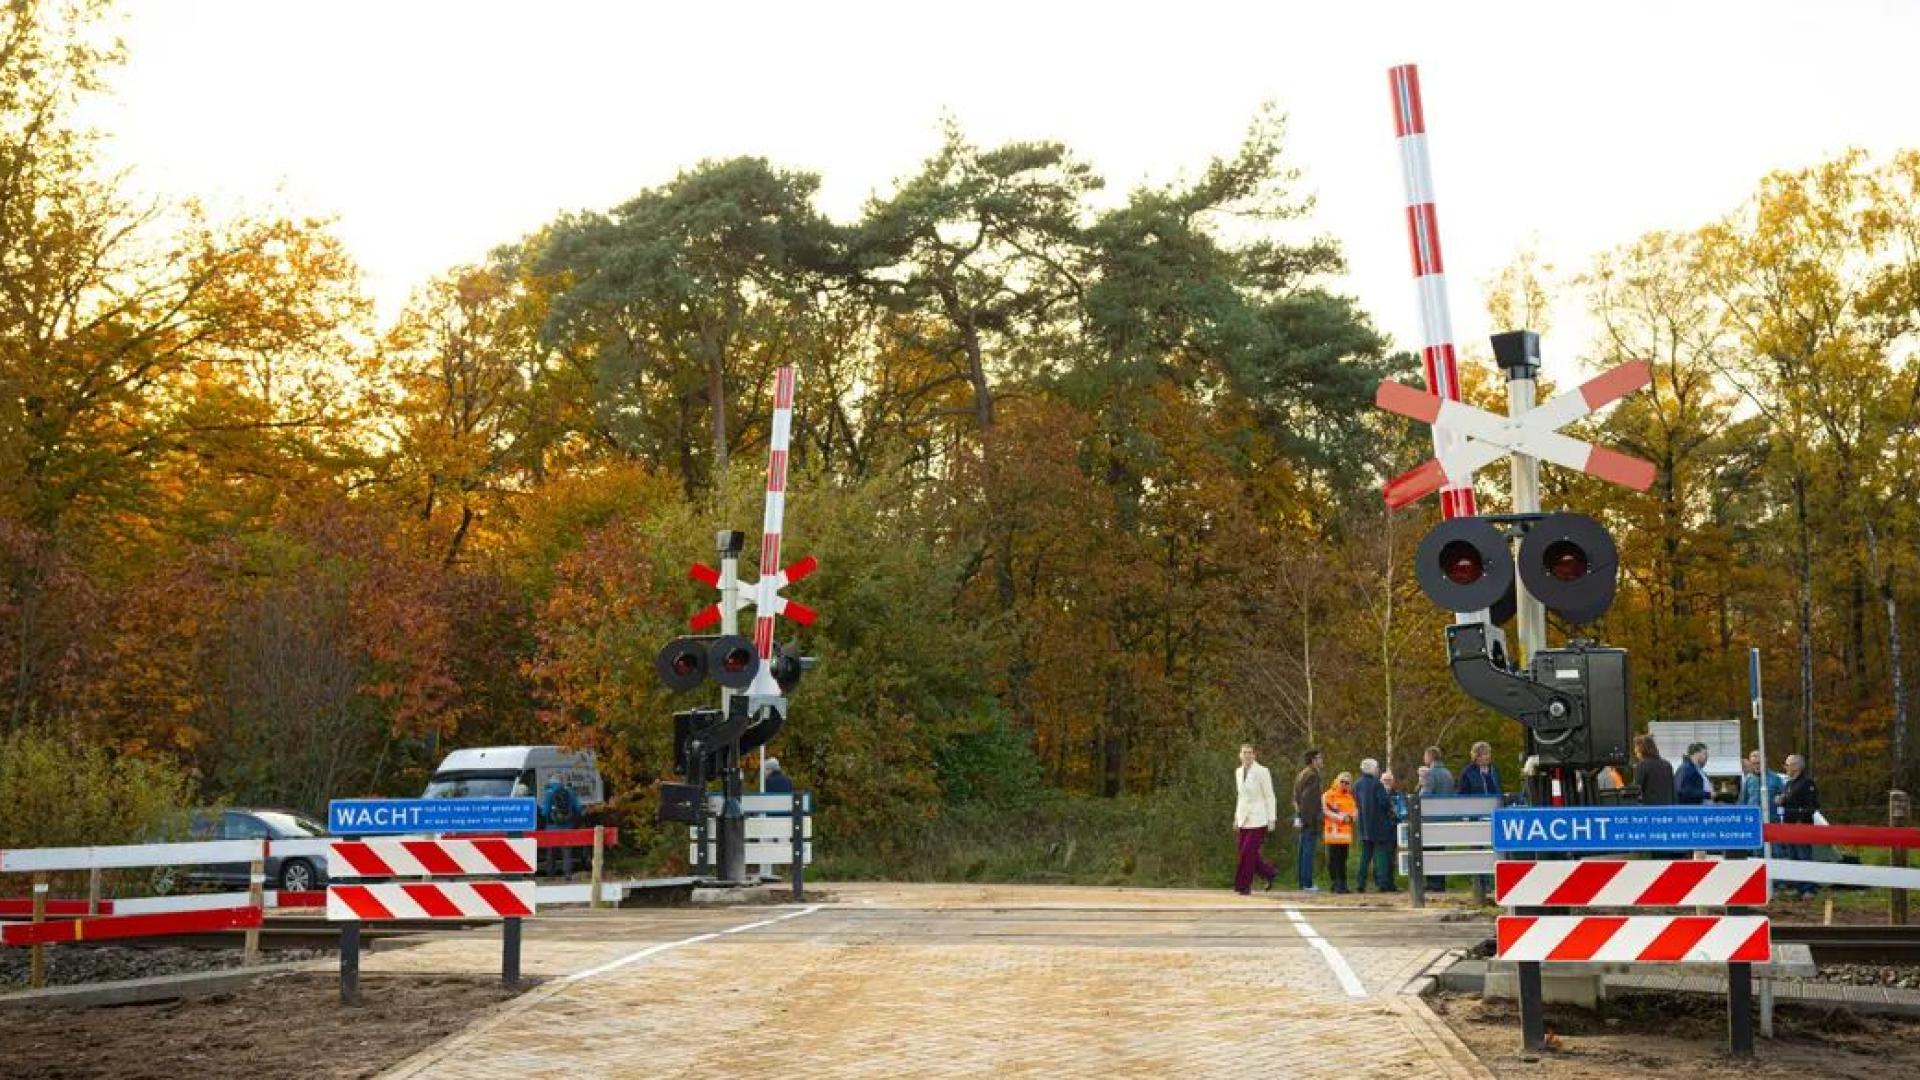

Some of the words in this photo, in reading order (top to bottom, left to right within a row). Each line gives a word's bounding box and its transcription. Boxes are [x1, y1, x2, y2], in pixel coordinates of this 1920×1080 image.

[337, 806, 422, 826] WACHT
[1614, 816, 1629, 824] tot
[1632, 815, 1649, 824] het
[1501, 817, 1612, 841] WACHT
